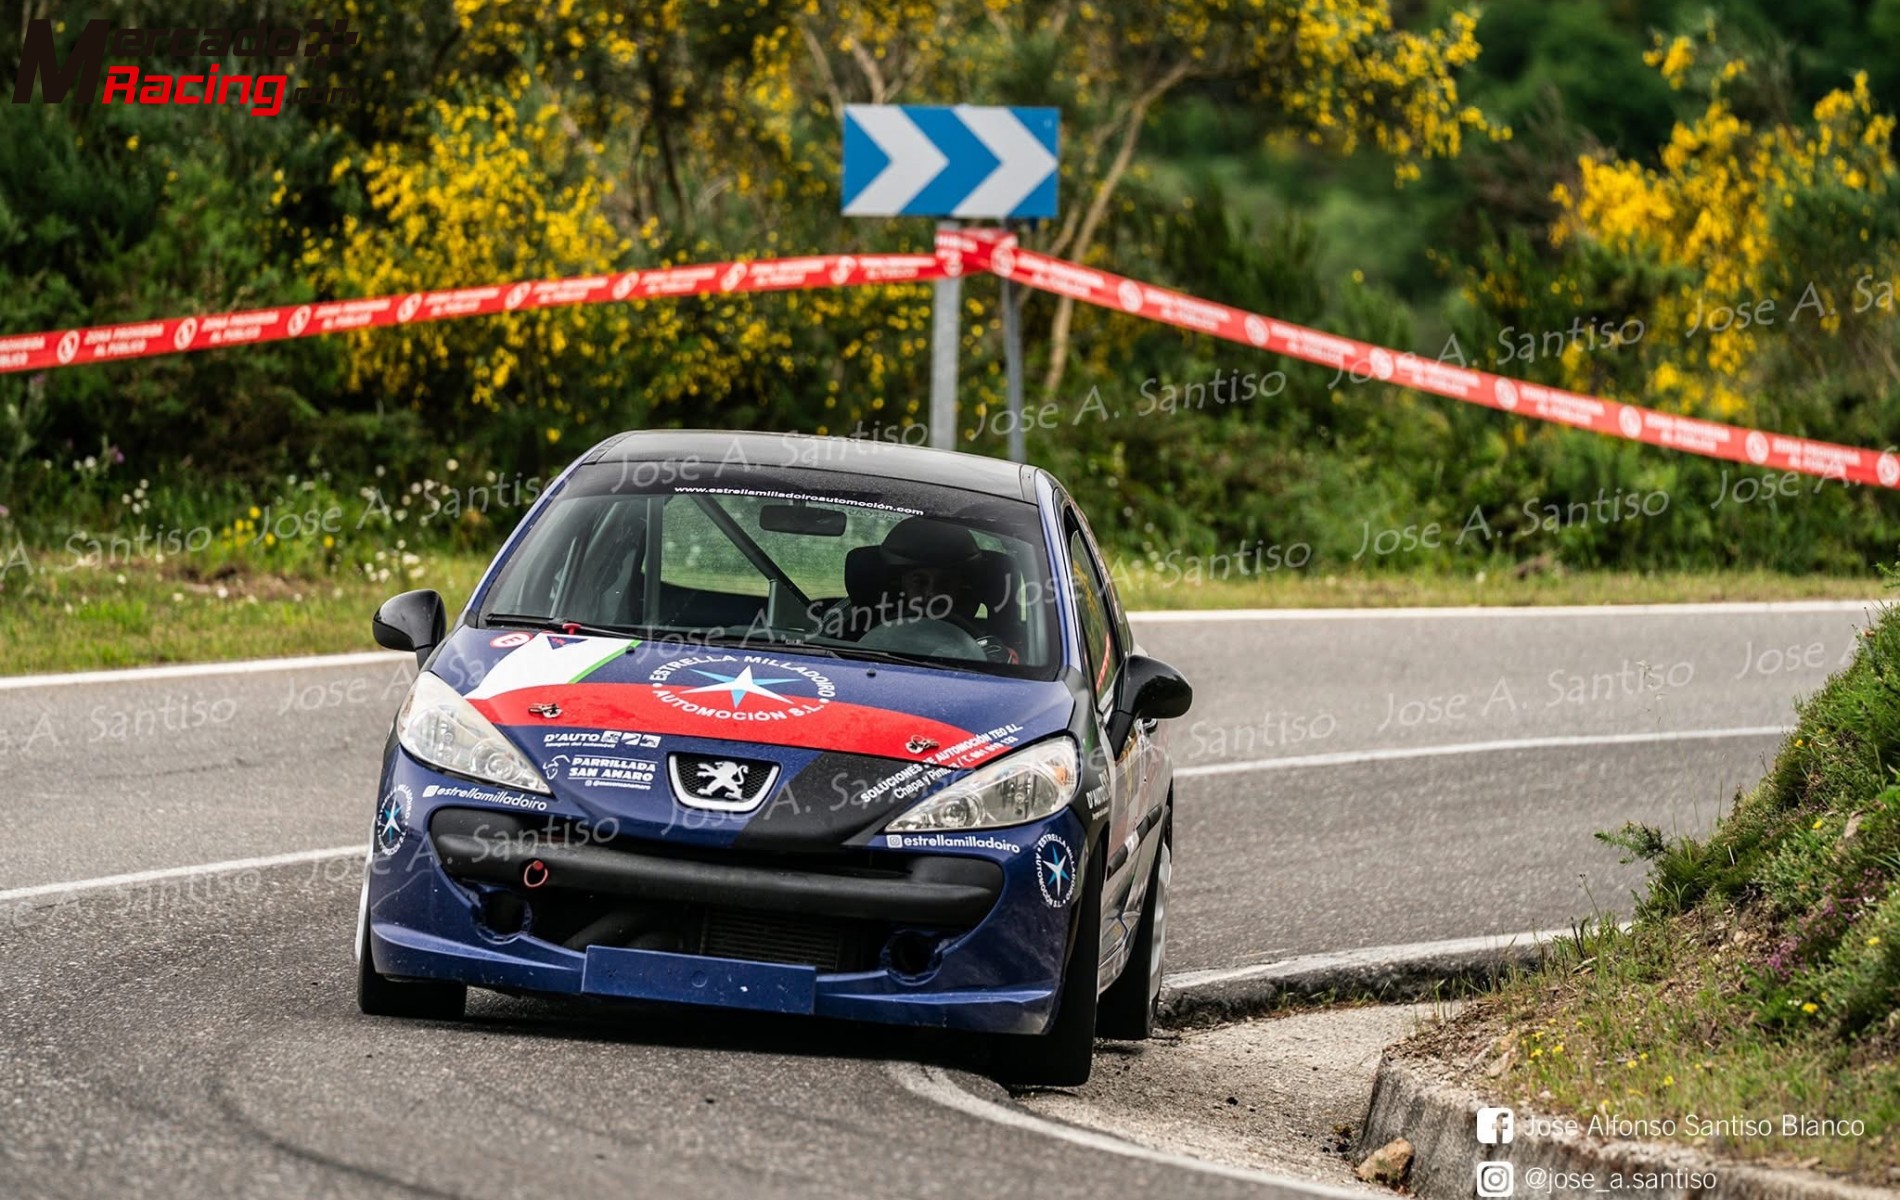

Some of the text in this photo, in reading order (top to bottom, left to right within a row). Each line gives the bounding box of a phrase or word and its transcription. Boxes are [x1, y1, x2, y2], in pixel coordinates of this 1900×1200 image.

[674, 485, 925, 517] www.estrellamilladoiroautomoción.com
[649, 654, 837, 698] ESTRELLA MILLADOIRO
[652, 689, 788, 721] AUTOMOCIÓN
[543, 733, 601, 743] D'AUTO
[569, 767, 654, 782] SAN AMARO
[572, 757, 656, 772] PARRILLADA
[861, 763, 922, 803] SOLUCIONES
[934, 733, 993, 762] AUTOMOCIÓN
[437, 786, 548, 812] estrellamilladoiro
[894, 780, 925, 800] Chapa
[923, 775, 932, 789] y
[904, 834, 1021, 854] estrellamilladoiro
[1038, 833, 1067, 849] ESTRELLA
